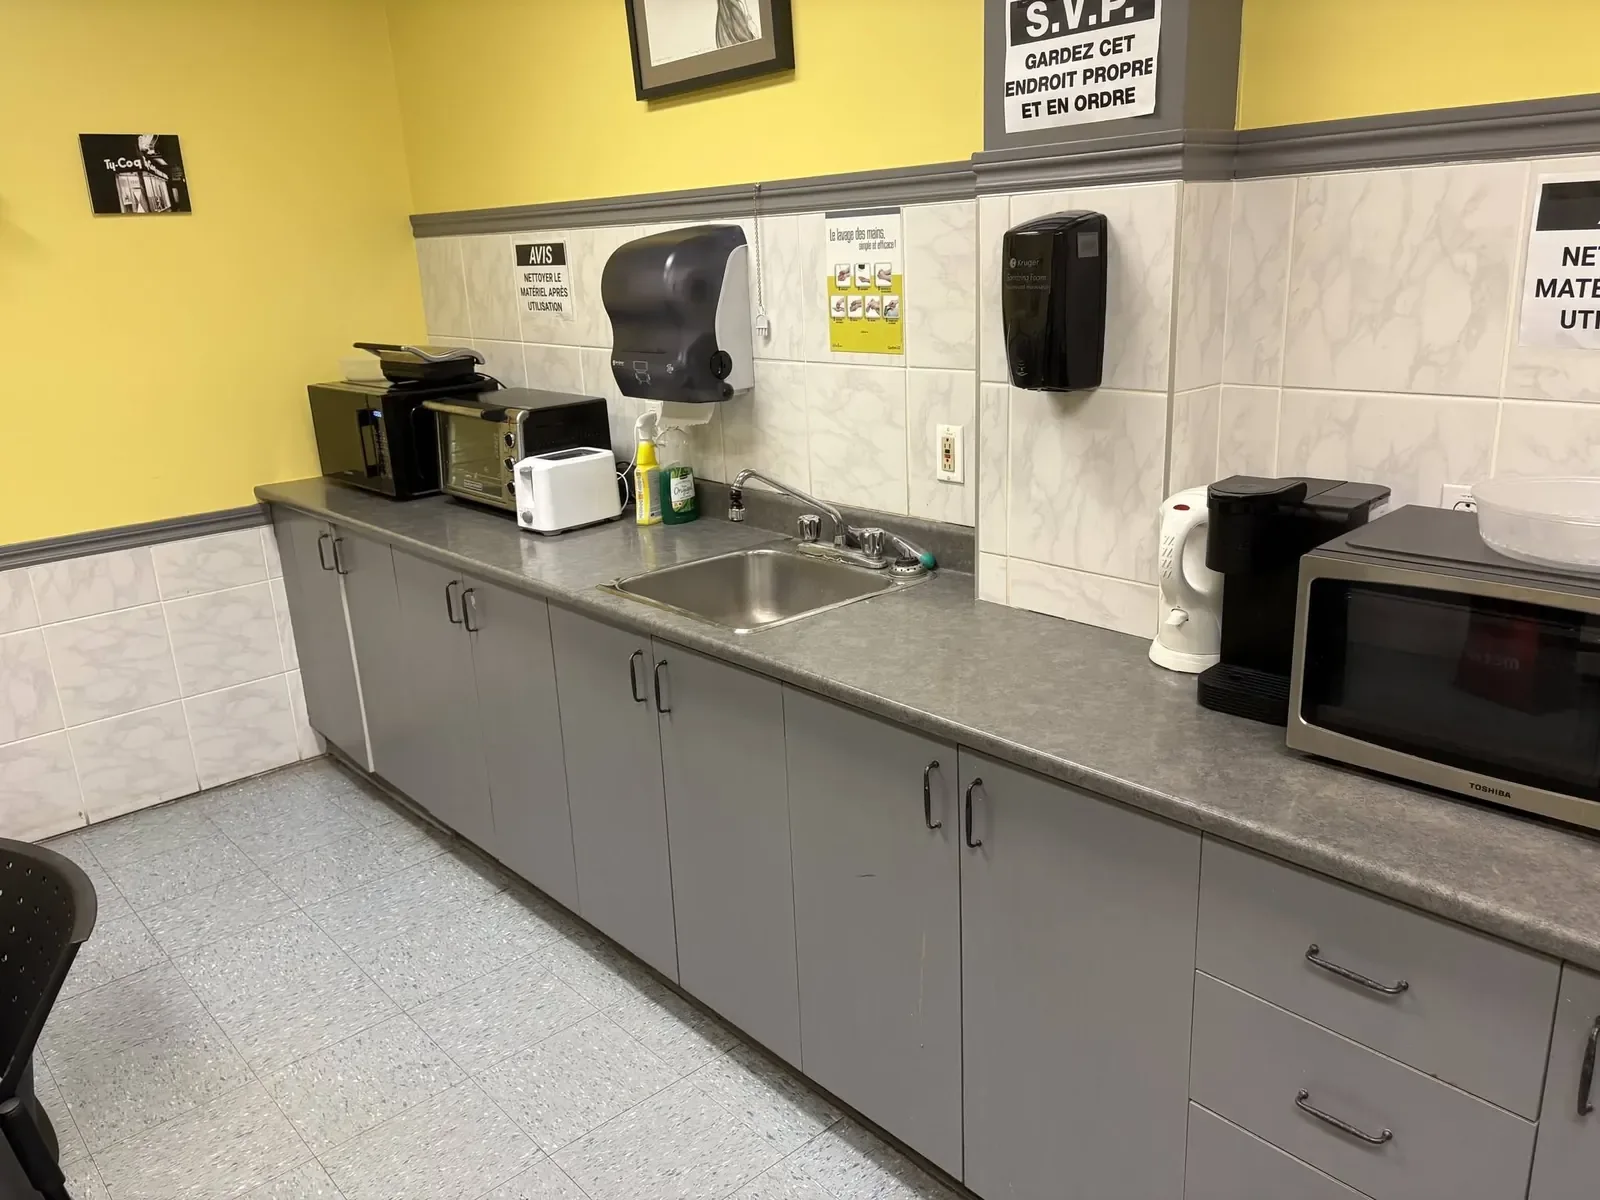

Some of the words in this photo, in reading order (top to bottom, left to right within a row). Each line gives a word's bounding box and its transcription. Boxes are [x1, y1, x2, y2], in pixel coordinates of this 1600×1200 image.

[1026, 0, 1135, 38] S.V.P.
[1025, 42, 1094, 70] GARDEZ
[1099, 34, 1136, 57] CET
[1005, 71, 1077, 97] ENDROIT
[1083, 57, 1154, 86] PROPRE
[1021, 101, 1042, 119] ET
[1047, 97, 1069, 116] EN
[1074, 87, 1136, 112] ORDRE
[829, 228, 836, 242] Le
[836, 227, 854, 244] lavage
[855, 225, 866, 240] des
[529, 245, 553, 264] AVIS
[858, 241, 872, 251] simple
[872, 240, 877, 250] et
[1562, 246, 1600, 267] NE
[523, 272, 553, 283] NETTOYER
[554, 272, 562, 283] LE
[520, 285, 547, 297] MATÉRIEL
[548, 285, 568, 297] APRÈS
[528, 301, 563, 312] UTILISATION
[1468, 782, 1512, 799] TOSHIBA
